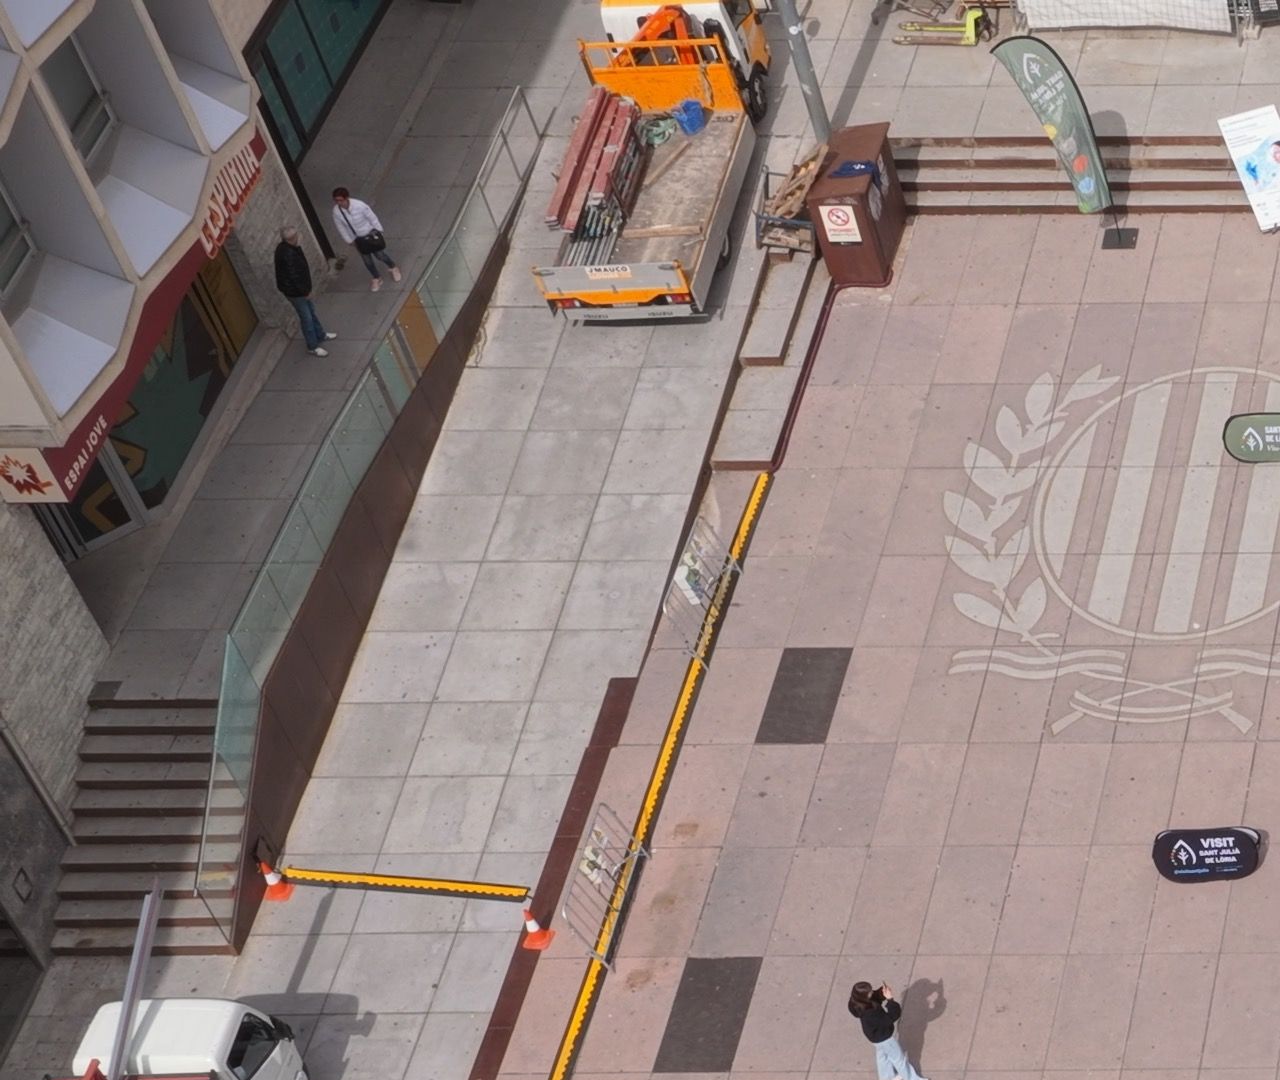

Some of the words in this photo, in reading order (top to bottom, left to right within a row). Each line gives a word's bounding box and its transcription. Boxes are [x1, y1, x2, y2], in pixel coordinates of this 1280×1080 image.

[64, 448, 89, 491] ESPAI
[86, 414, 108, 453] JOVE
[1200, 837, 1235, 849] VISIT
[1199, 849, 1218, 857] SANT
[1219, 847, 1241, 855] JULIÀ
